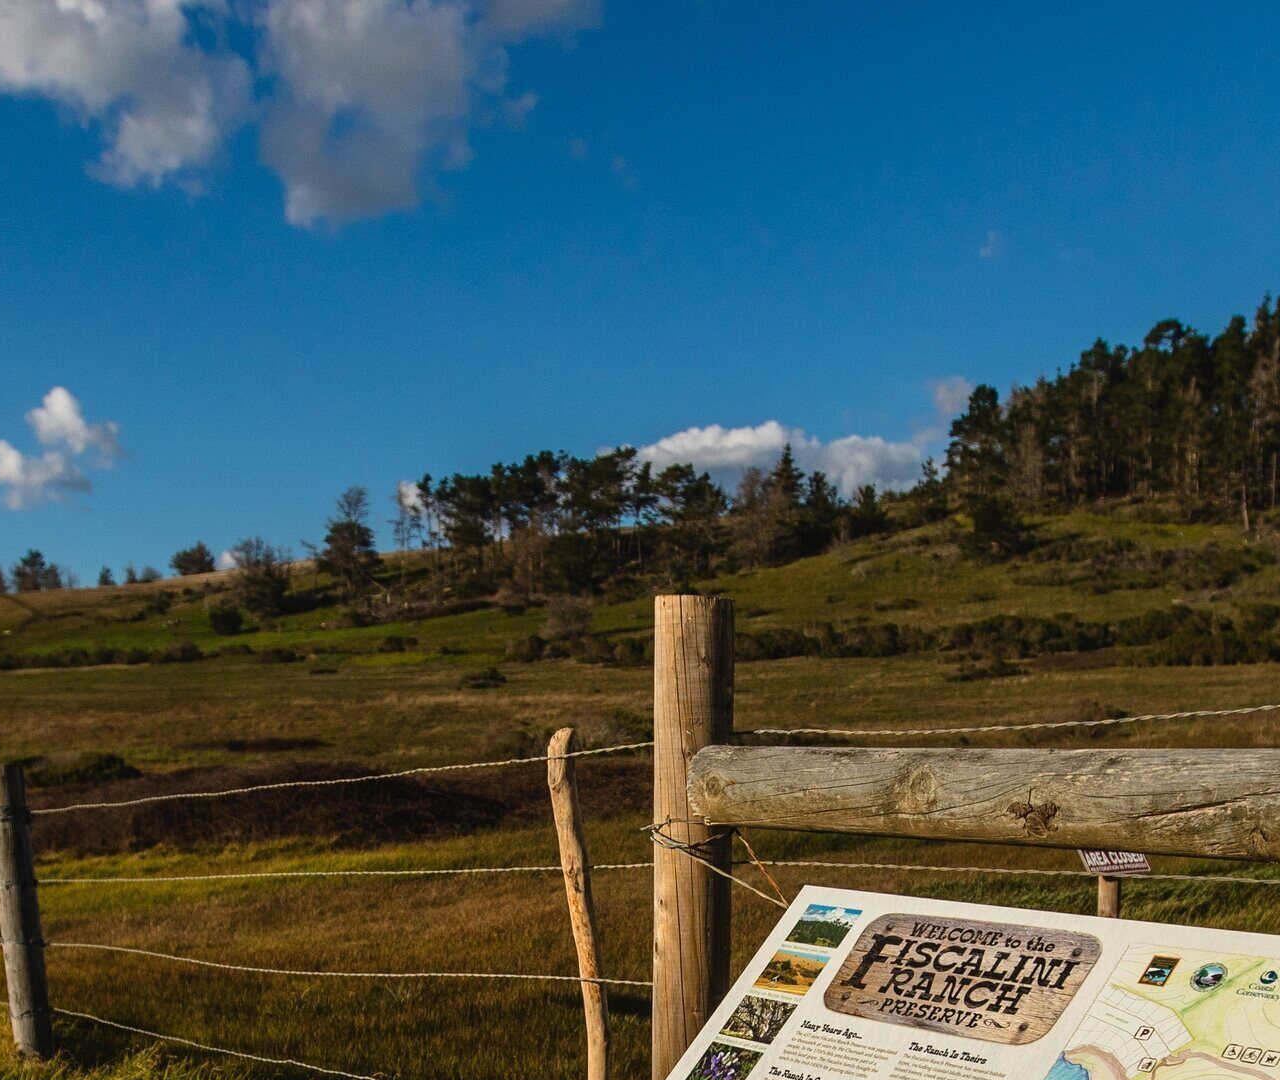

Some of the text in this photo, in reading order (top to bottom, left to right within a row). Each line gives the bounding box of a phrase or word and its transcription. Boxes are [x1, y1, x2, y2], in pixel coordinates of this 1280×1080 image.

[1084, 850, 1145, 866] AREA CLOSED
[910, 922, 1055, 953] WELCOME to the
[840, 933, 1080, 990] FISCALINI
[878, 967, 1032, 1014] RANCH
[878, 998, 985, 1028] PRESERVE
[801, 1020, 821, 1032] Many
[822, 1024, 841, 1037] Years
[909, 1042, 988, 1064] The Ranch Is Theirs
[769, 1066, 784, 1076] The
